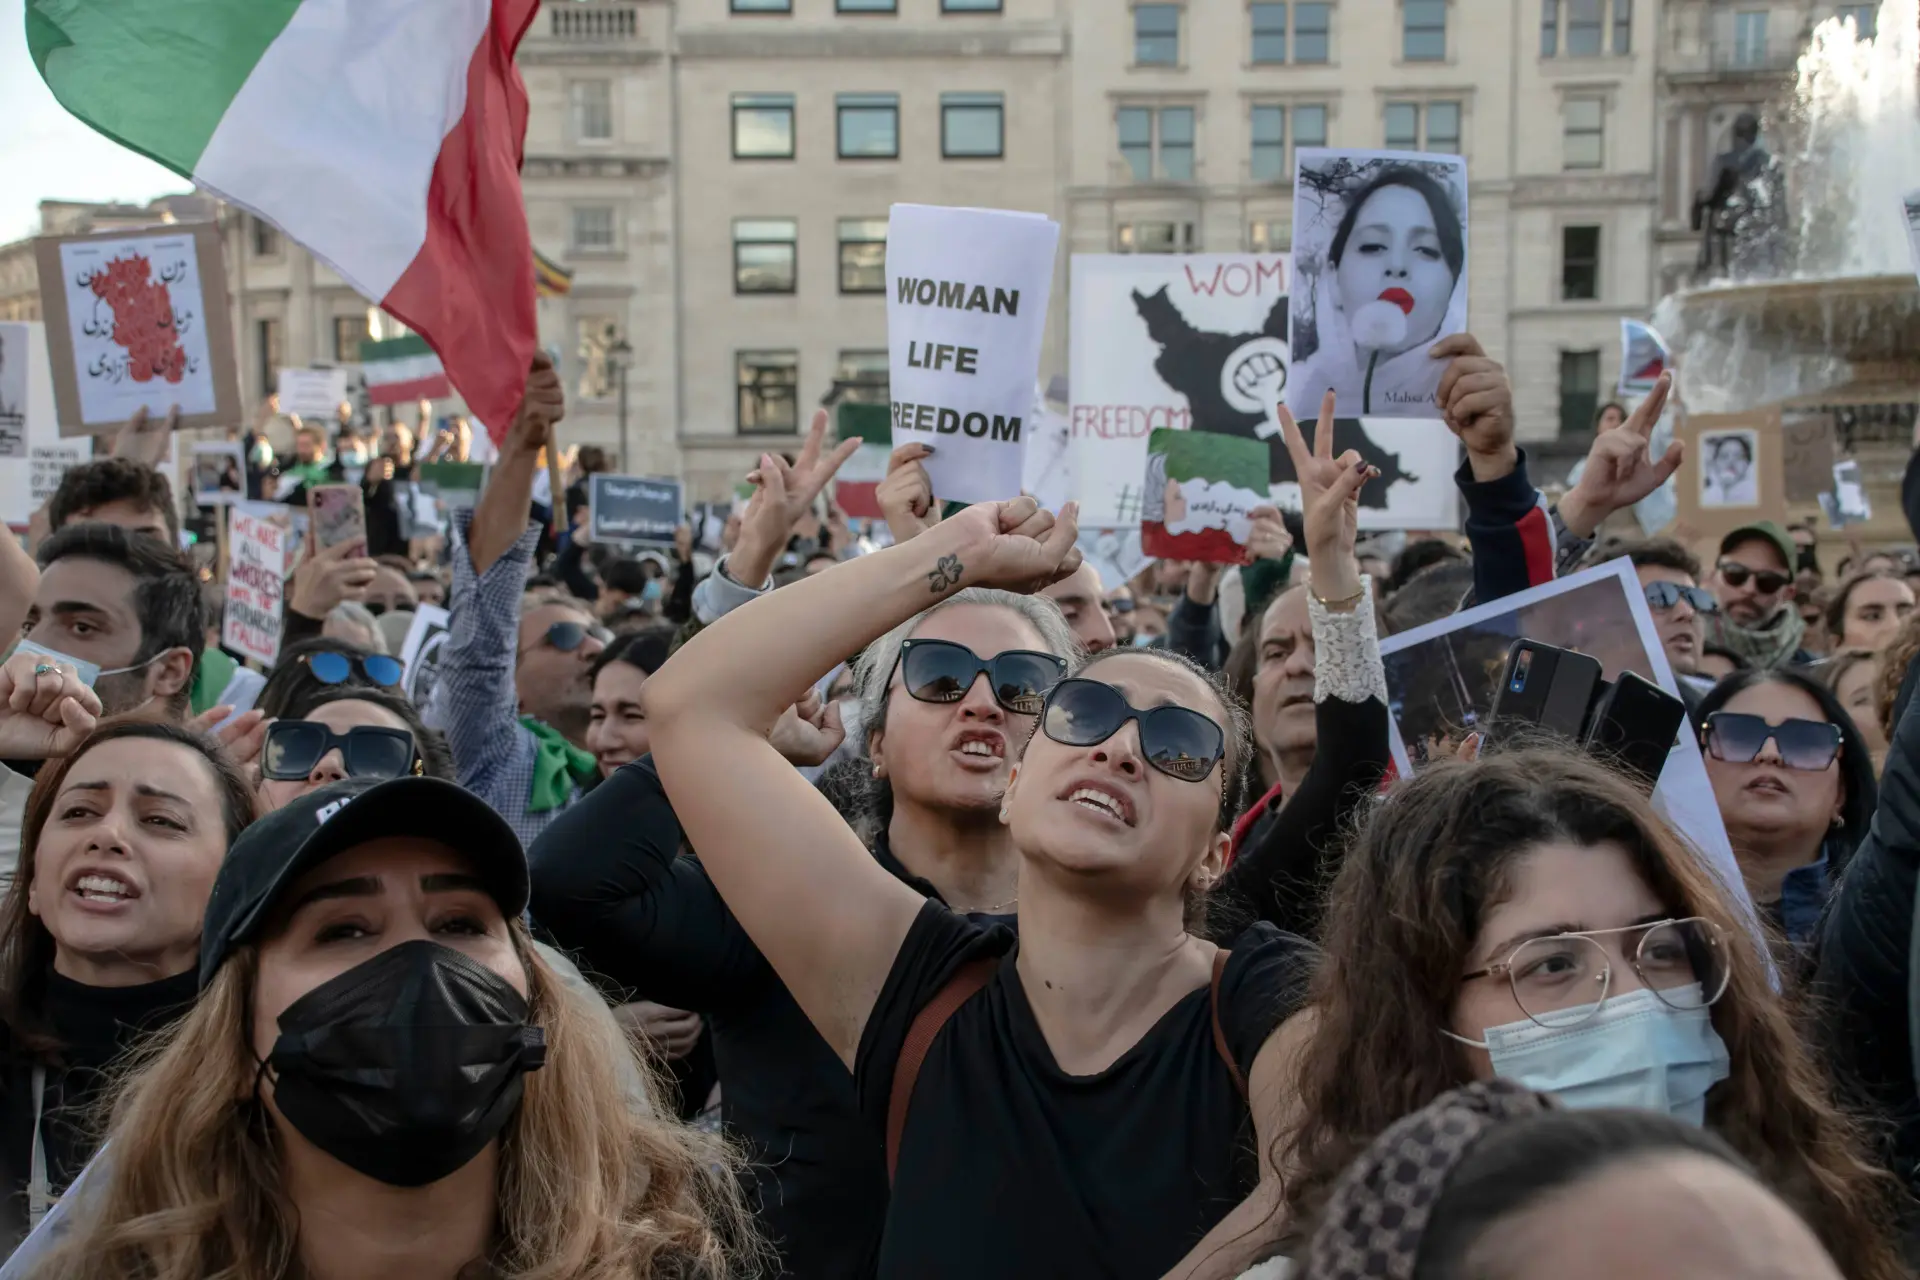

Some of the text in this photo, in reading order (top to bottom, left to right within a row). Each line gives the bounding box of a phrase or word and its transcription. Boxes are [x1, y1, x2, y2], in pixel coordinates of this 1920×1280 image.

[897, 277, 1020, 316] WOMAN
[1184, 258, 1291, 298] WOM
[908, 340, 979, 375] LIFE
[1384, 391, 1422, 403] Mahsa
[892, 400, 1022, 443] REEDOM
[1072, 405, 1189, 439] FREEDOM
